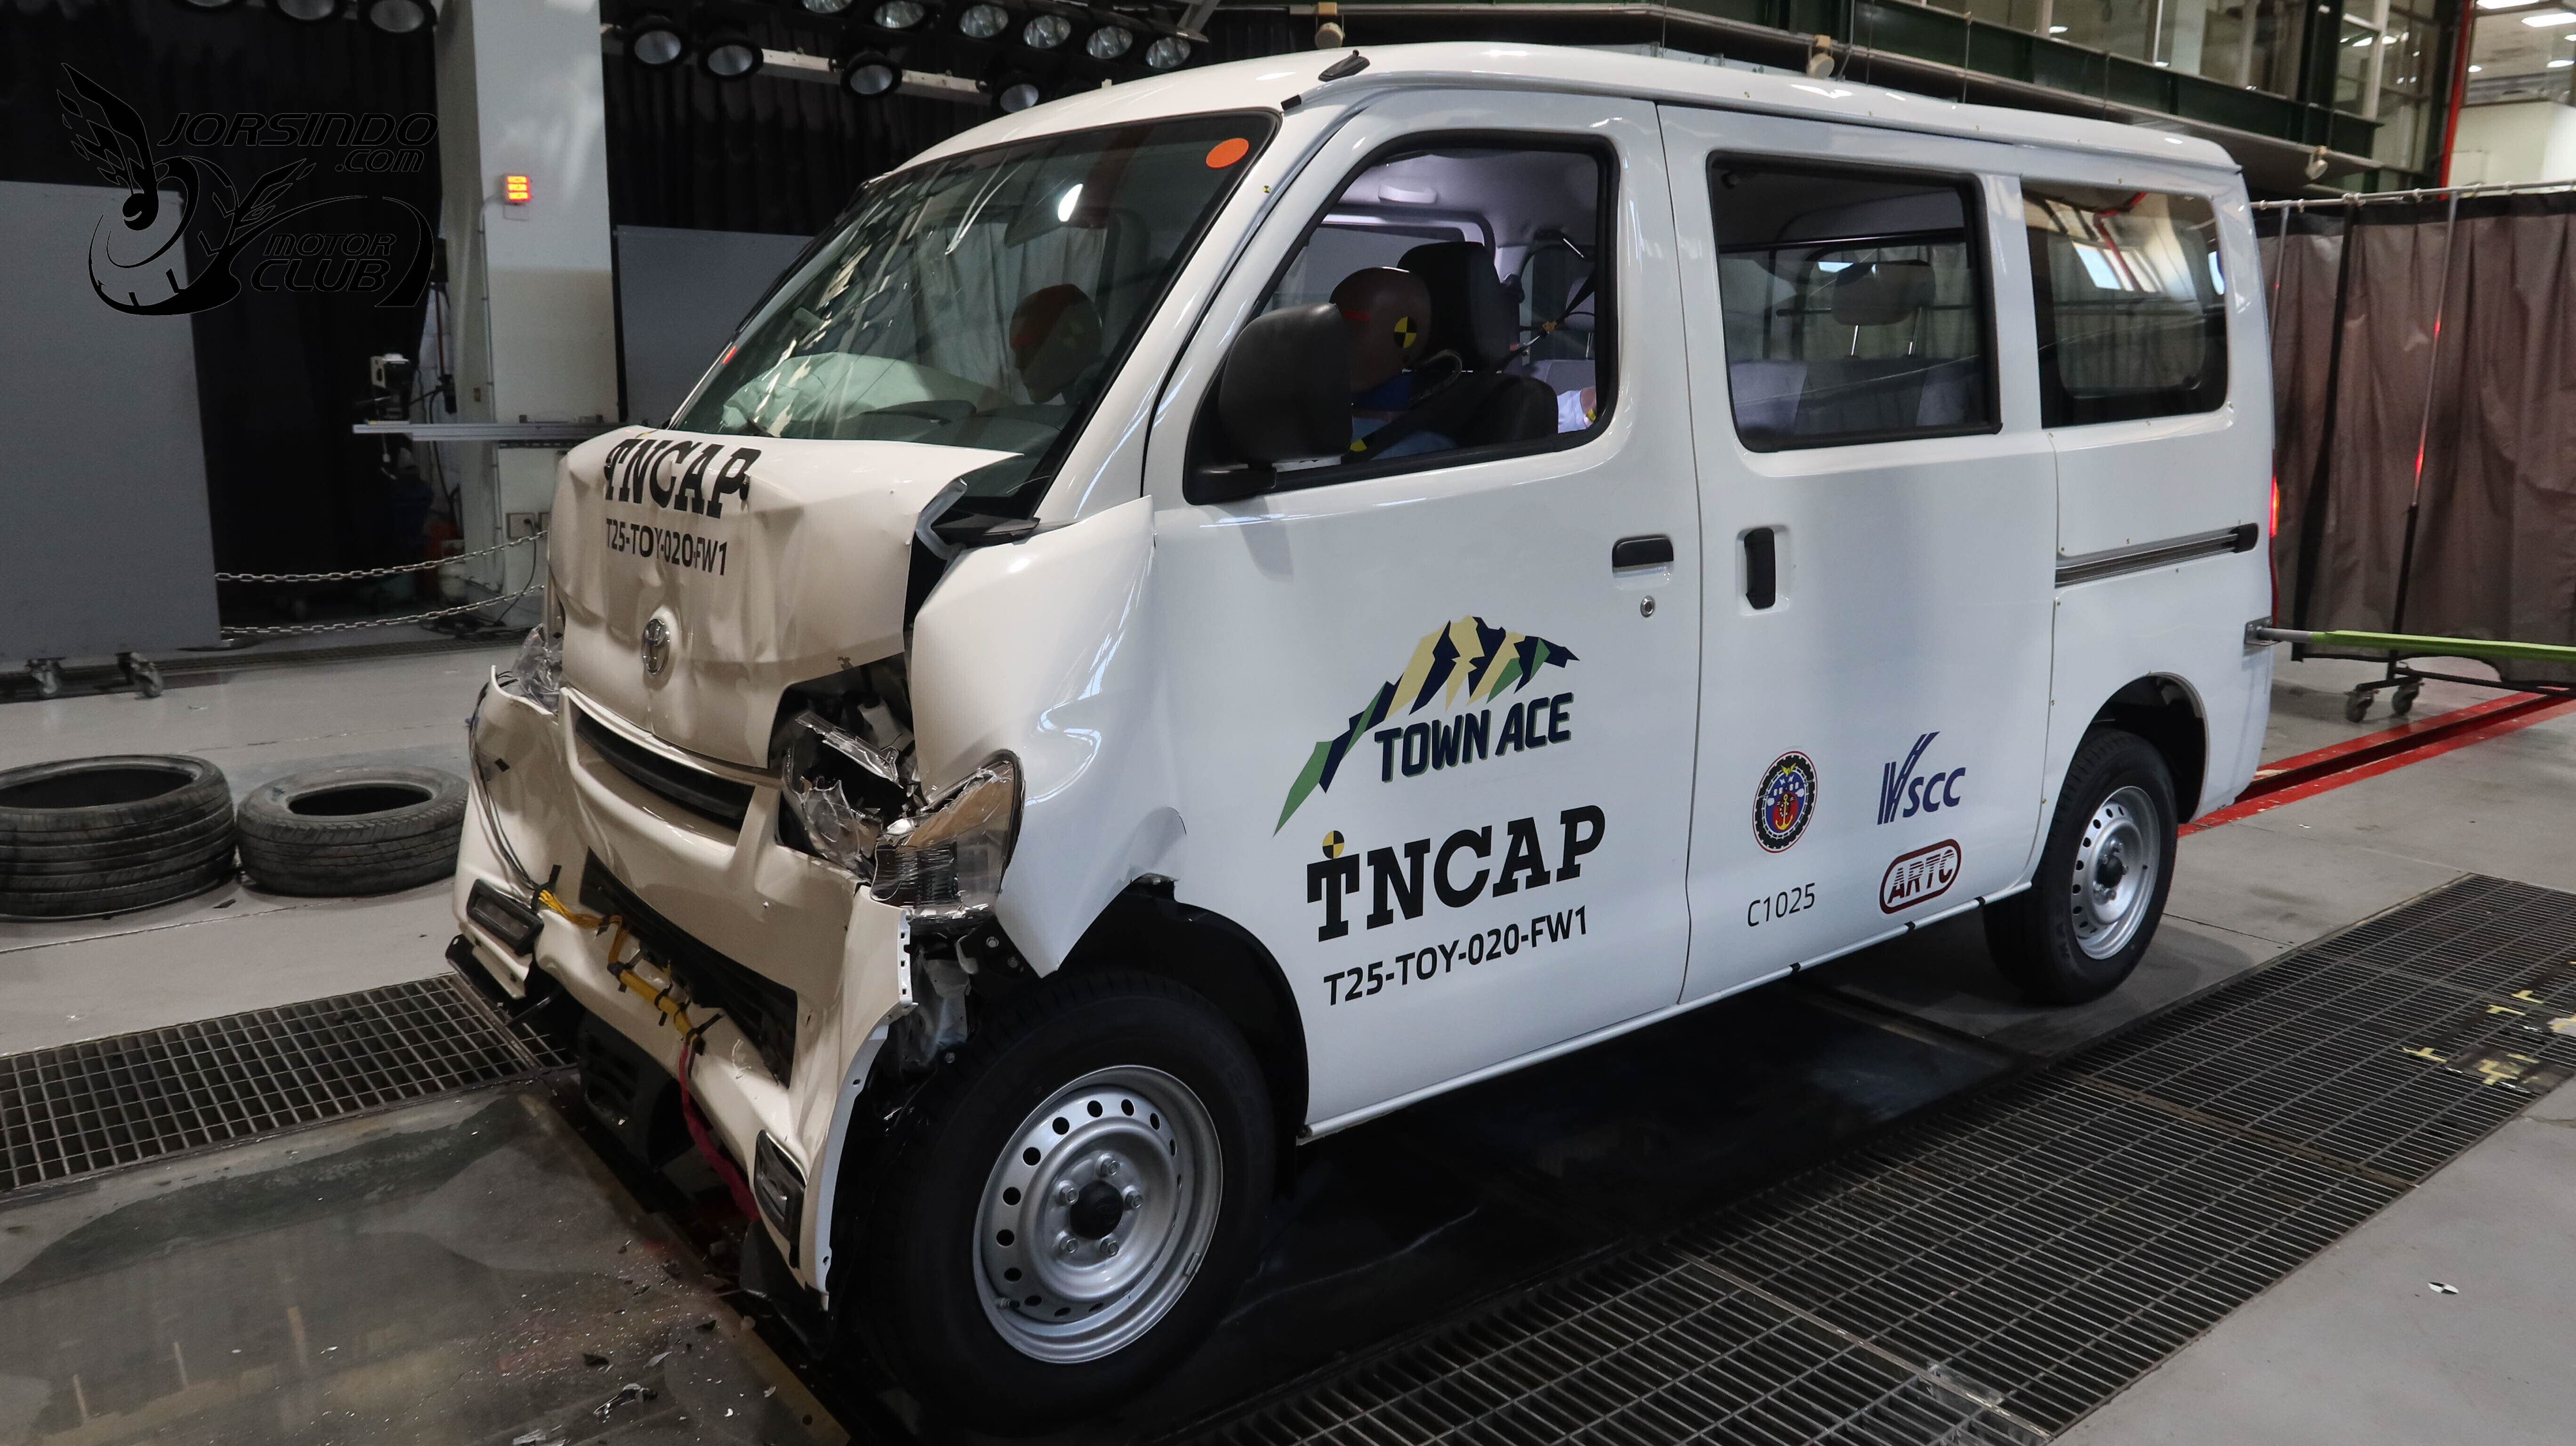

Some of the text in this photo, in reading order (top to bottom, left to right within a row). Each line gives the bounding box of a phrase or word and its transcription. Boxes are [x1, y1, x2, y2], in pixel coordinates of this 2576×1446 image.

[604, 438, 762, 519] TNCAP
[606, 518, 728, 576] T25-TOY-020-FW1
[1374, 692, 1574, 783] TOWN ACE
[1307, 805, 1606, 942] TNCAP
[1747, 882, 1816, 927] C1025
[1887, 849, 1955, 904] ARTC
[1323, 905, 1586, 1006] T25-TOY-020-FW1
